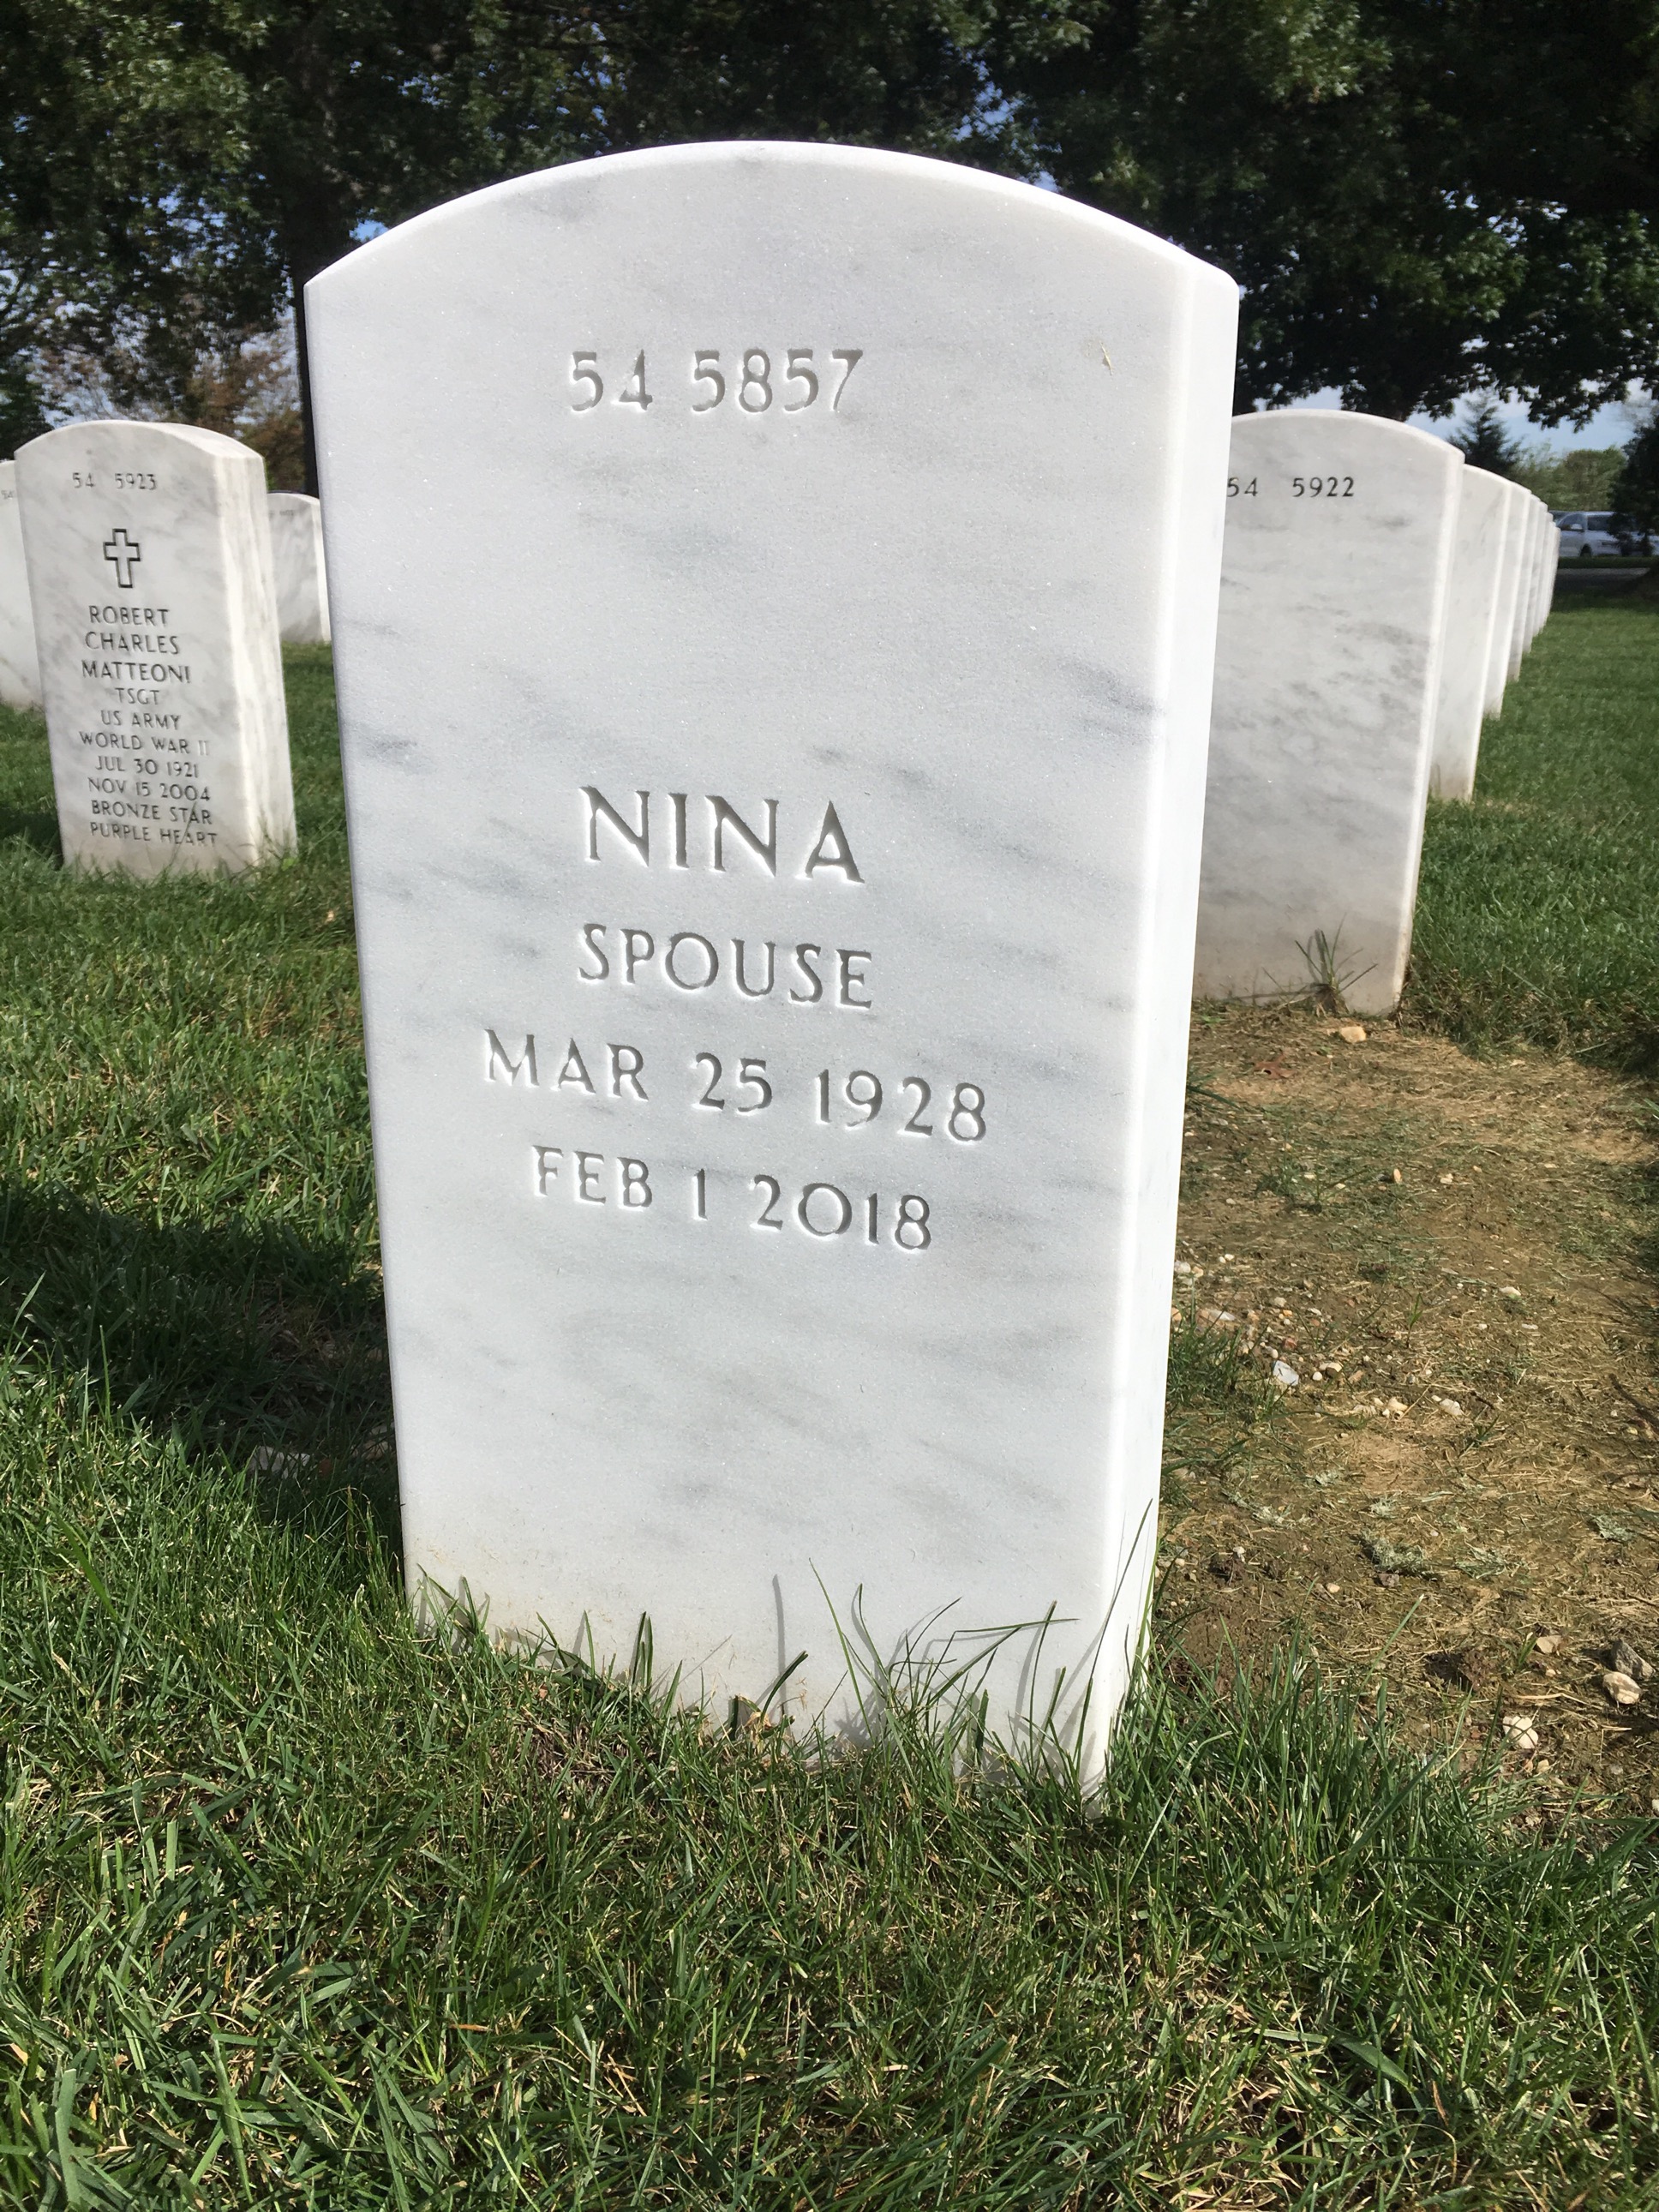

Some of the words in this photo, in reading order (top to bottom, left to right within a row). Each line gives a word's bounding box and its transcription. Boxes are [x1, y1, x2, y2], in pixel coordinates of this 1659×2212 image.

[571, 348, 653, 413] 54
[690, 346, 864, 413] 5857
[72, 472, 95, 489] 54
[114, 472, 158, 491] 5923
[1227, 477, 1259, 497] 54
[1292, 476, 1355, 497] 5922
[88, 605, 170, 626] ROBERT
[85, 631, 181, 655] CHARLES
[81, 659, 191, 684] MATTEONI
[115, 687, 160, 705] TSGT
[100, 710, 122, 726] US
[131, 712, 182, 730] ARMY
[79, 731, 143, 750] WORLD
[151, 736, 190, 754] WAR
[197, 740, 211, 756] II
[95, 755, 126, 772] JUL
[133, 758, 159, 775] 30
[166, 761, 200, 778] 1921
[87, 776, 128, 794] NOV
[135, 782, 151, 797] 15
[159, 782, 211, 801] 2004
[91, 800, 161, 820] BRONZE
[169, 806, 213, 825] STAR
[90, 822, 151, 842] PURPLE
[159, 828, 218, 847] HEART
[578, 785, 865, 884] NINA
[578, 922, 872, 1010] SPOUSE
[484, 1028, 649, 1102] MAR
[689, 1051, 773, 1116] 25
[812, 1068, 987, 1142] 1928
[530, 1144, 653, 1210] FEB
[692, 1168, 708, 1221] 1
[749, 1173, 932, 1251] 2018
